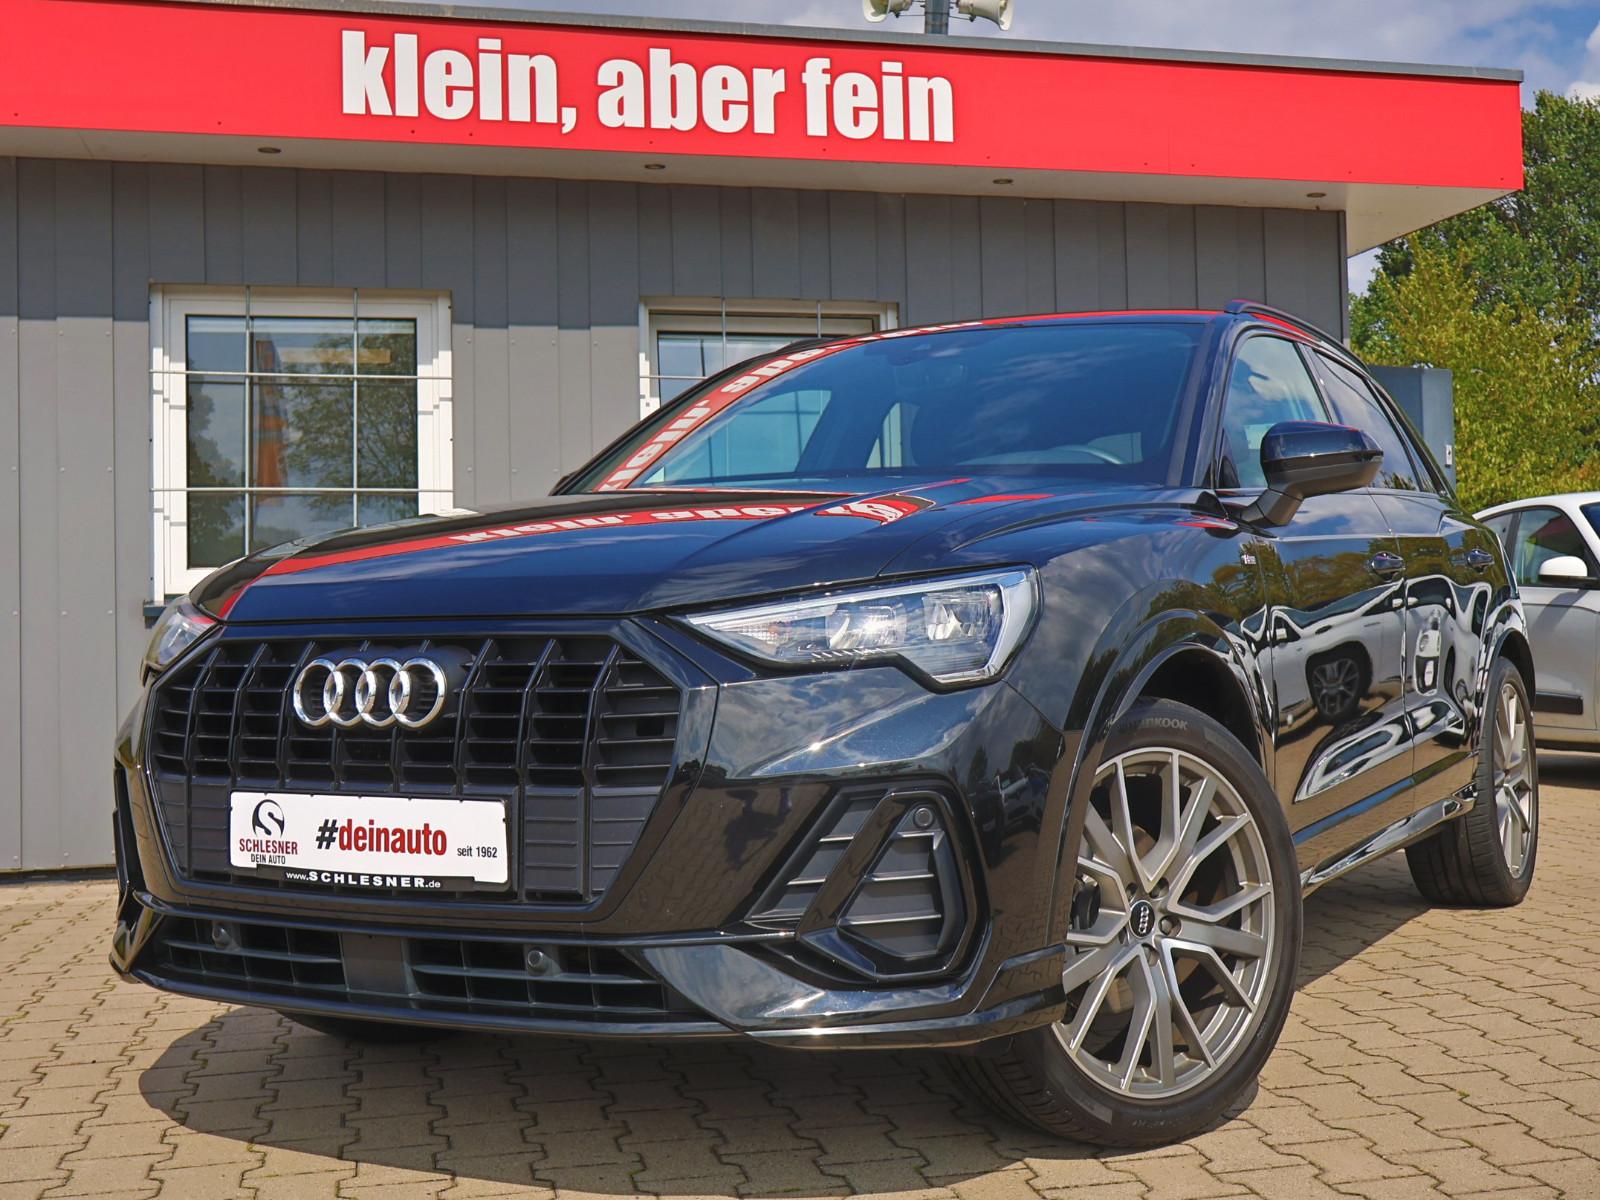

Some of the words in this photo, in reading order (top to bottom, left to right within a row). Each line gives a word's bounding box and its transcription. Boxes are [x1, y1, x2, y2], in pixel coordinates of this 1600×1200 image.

[341, 29, 577, 134] klein,
[597, 47, 785, 134] aber
[801, 57, 955, 143] fein
[239, 838, 298, 855] SCHLESNER
[315, 818, 448, 857] #deinauto
[250, 853, 267, 864] DEIN
[268, 854, 286, 865] AUTO
[457, 845, 473, 857] seit
[476, 846, 498, 858] 1962
[285, 870, 441, 889] www.SCHLESNER.de
